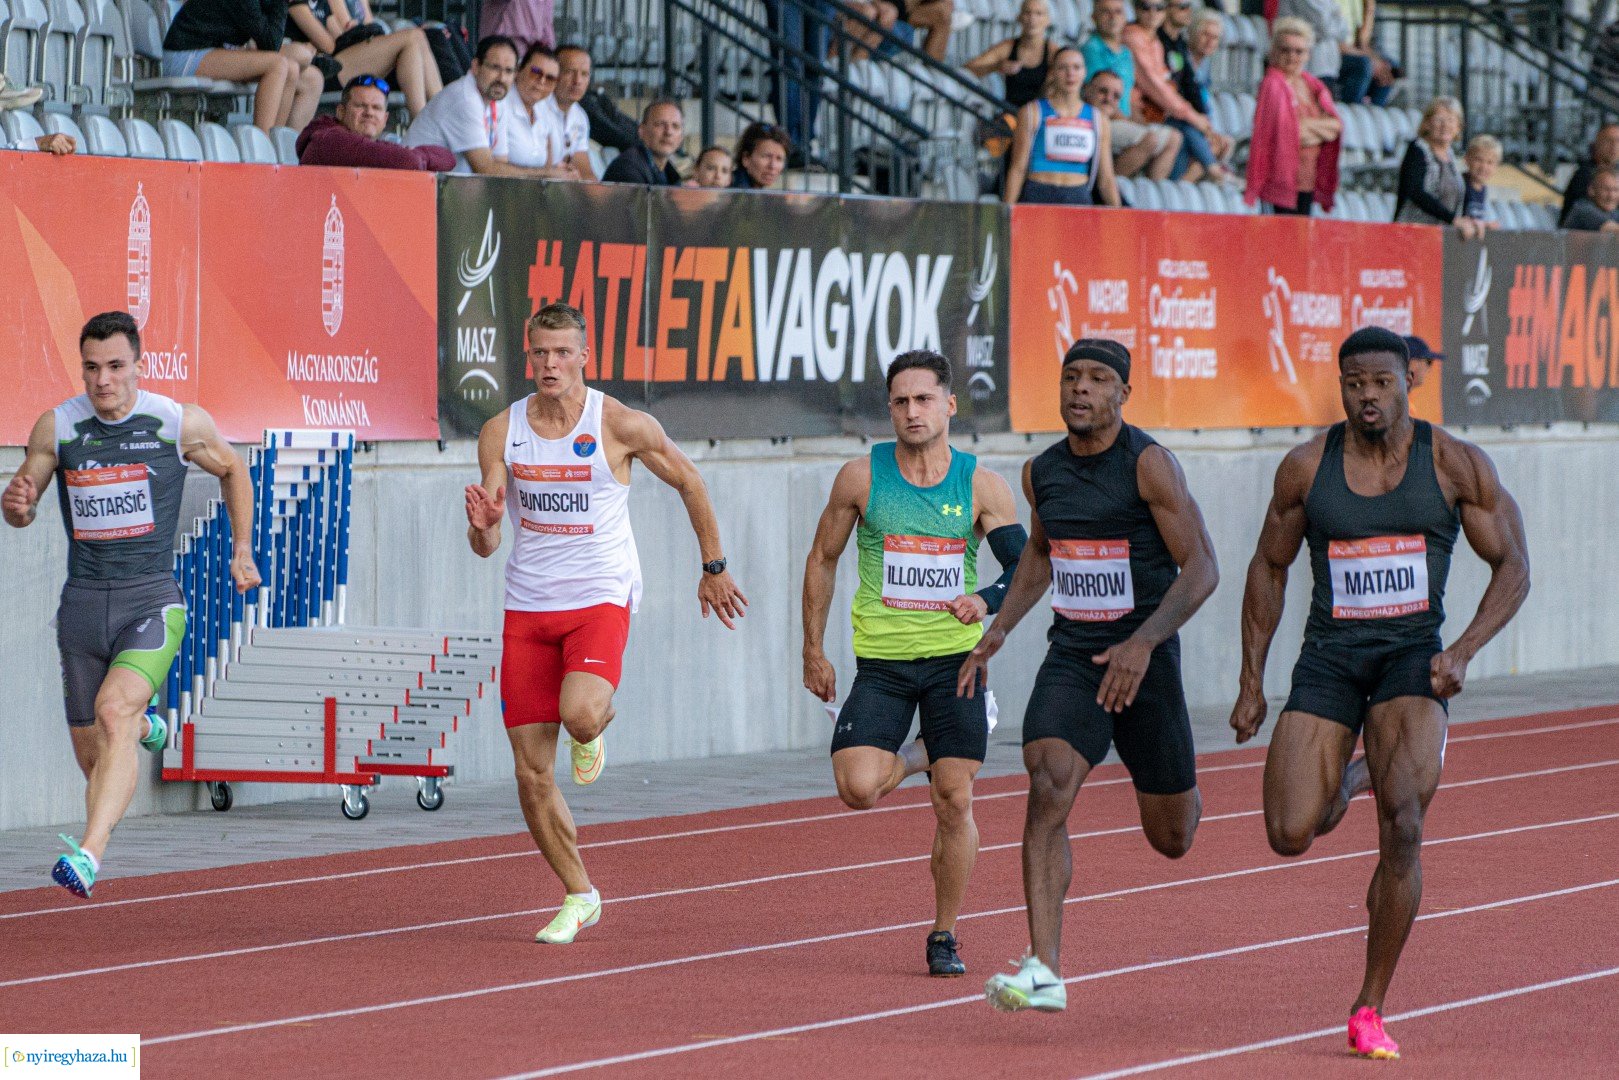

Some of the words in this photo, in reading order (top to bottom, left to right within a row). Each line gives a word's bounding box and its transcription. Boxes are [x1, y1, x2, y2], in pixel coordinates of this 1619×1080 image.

[457, 327, 497, 363] MASZ
[142, 345, 188, 380] ORSZÁG
[287, 349, 378, 383] MAGYARORSZÁG
[302, 392, 370, 427] KORMÁNYA
[74, 490, 147, 517] ŠUŠTARŠIČ
[520, 490, 588, 512] BUNDSCHU
[887, 565, 960, 588] ILLOVSZKY
[1057, 571, 1125, 597] MORROW
[1345, 566, 1414, 595] MATADI
[886, 600, 940, 610] NYÍREGYHÁZA
[1403, 604, 1423, 612] 2023
